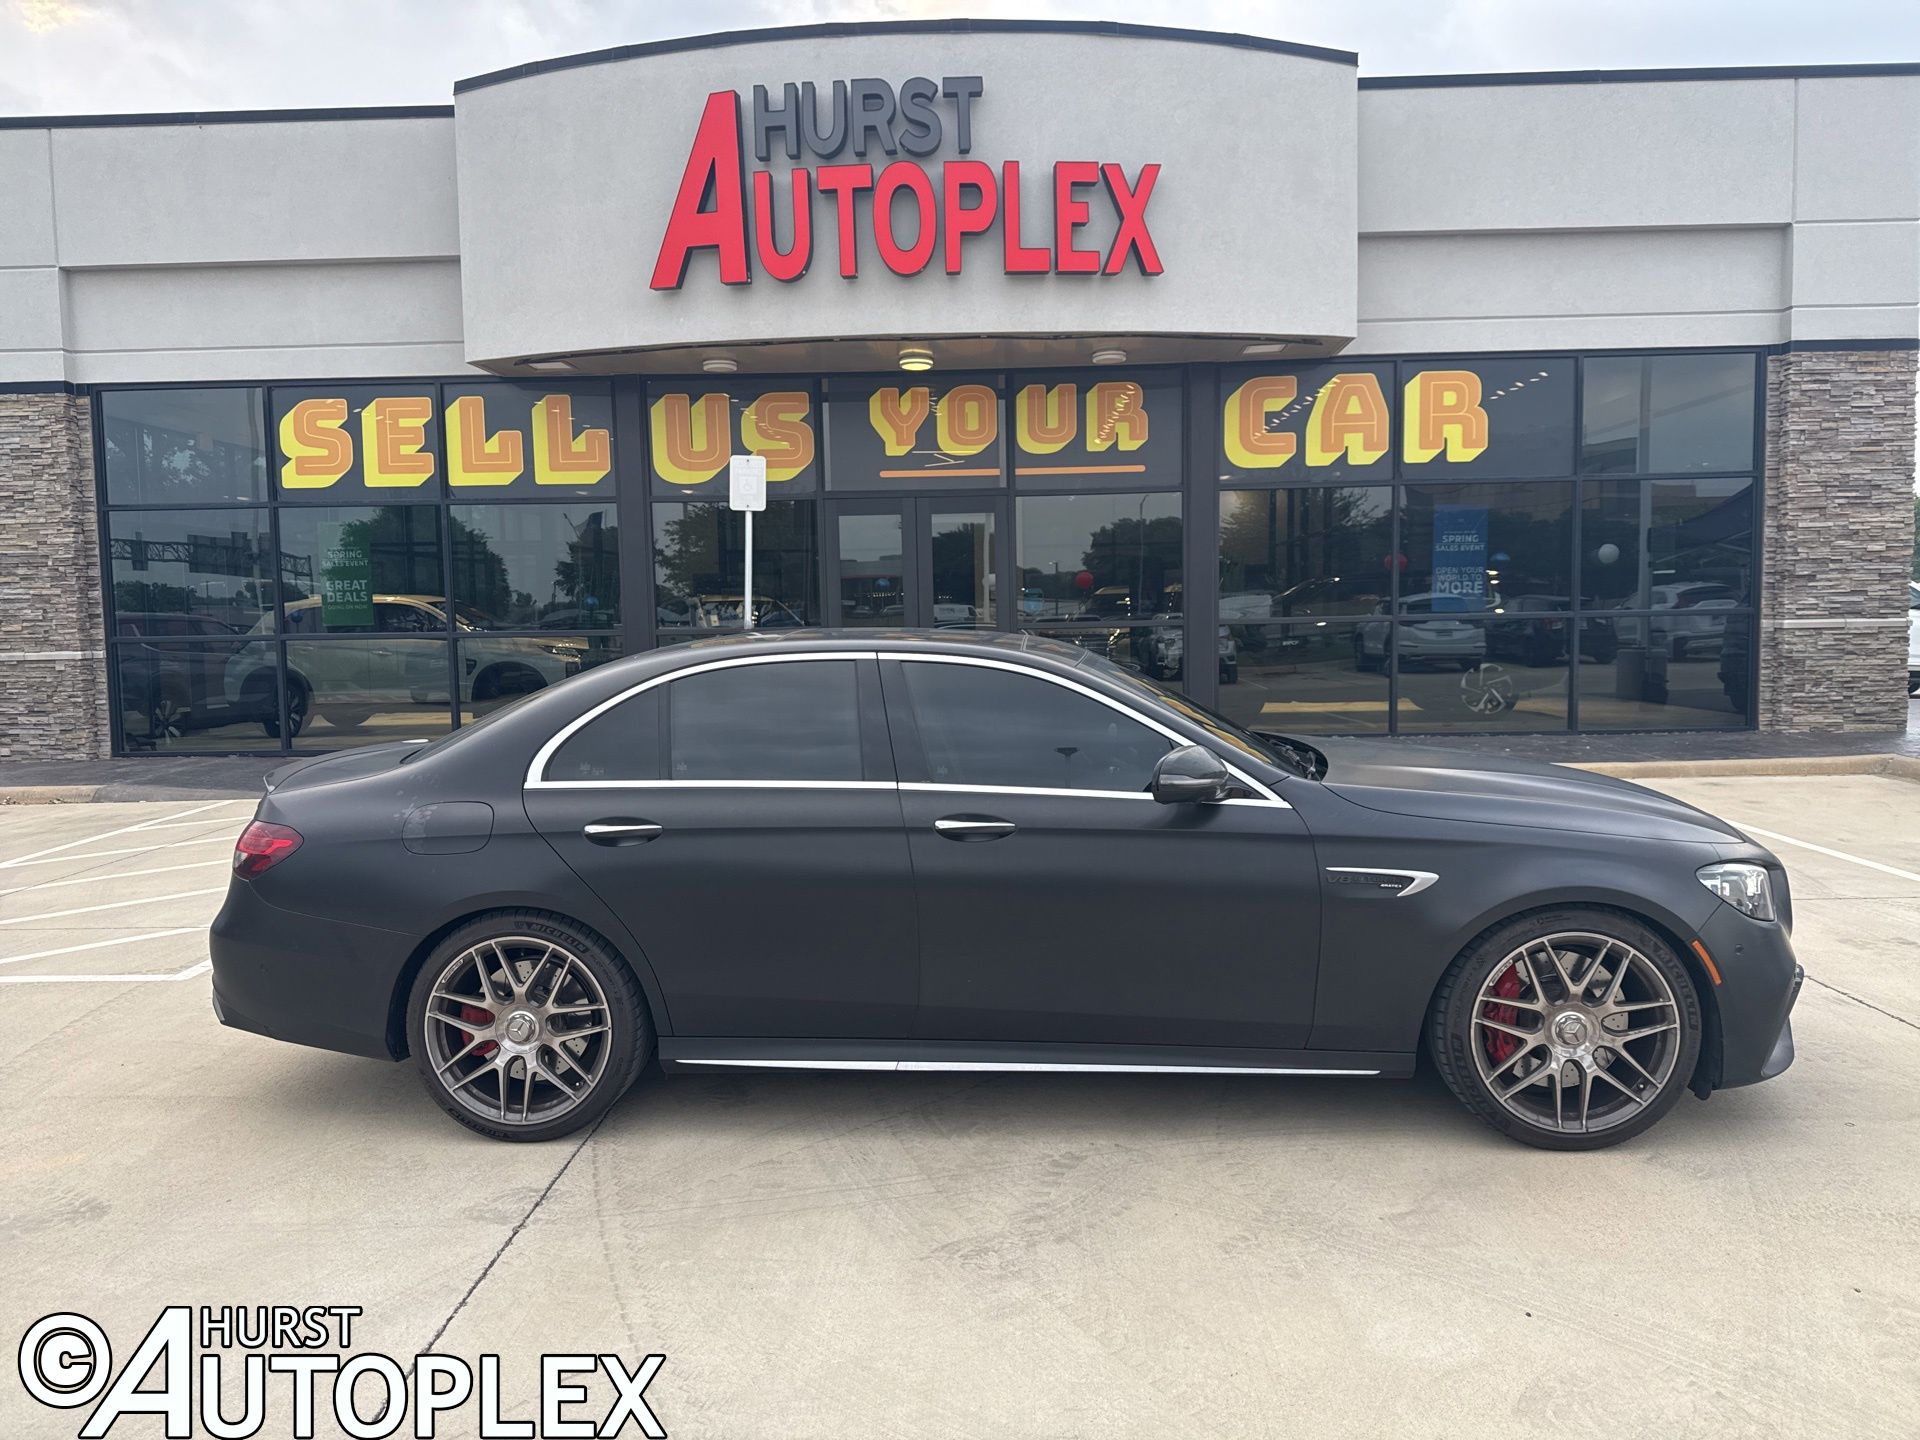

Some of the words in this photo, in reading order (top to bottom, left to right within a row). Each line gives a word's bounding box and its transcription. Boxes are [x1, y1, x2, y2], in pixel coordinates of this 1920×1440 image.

[752, 75, 984, 162] HURST
[649, 89, 1164, 291] AUTOPLEX
[279, 393, 613, 490] SELL
[650, 391, 815, 485] US
[869, 380, 1149, 457] YOUR
[1223, 369, 1489, 469] CAR
[1442, 534, 1479, 543] SPRING
[1434, 544, 1459, 552] SALES
[1460, 543, 1485, 551] EVENT
[327, 550, 363, 559] SPRING
[1435, 566, 1458, 574] OPEN
[1461, 566, 1484, 574] YOUR
[326, 579, 368, 591] GREAT
[1436, 581, 1483, 594] MORE
[326, 591, 368, 603] DEALS
